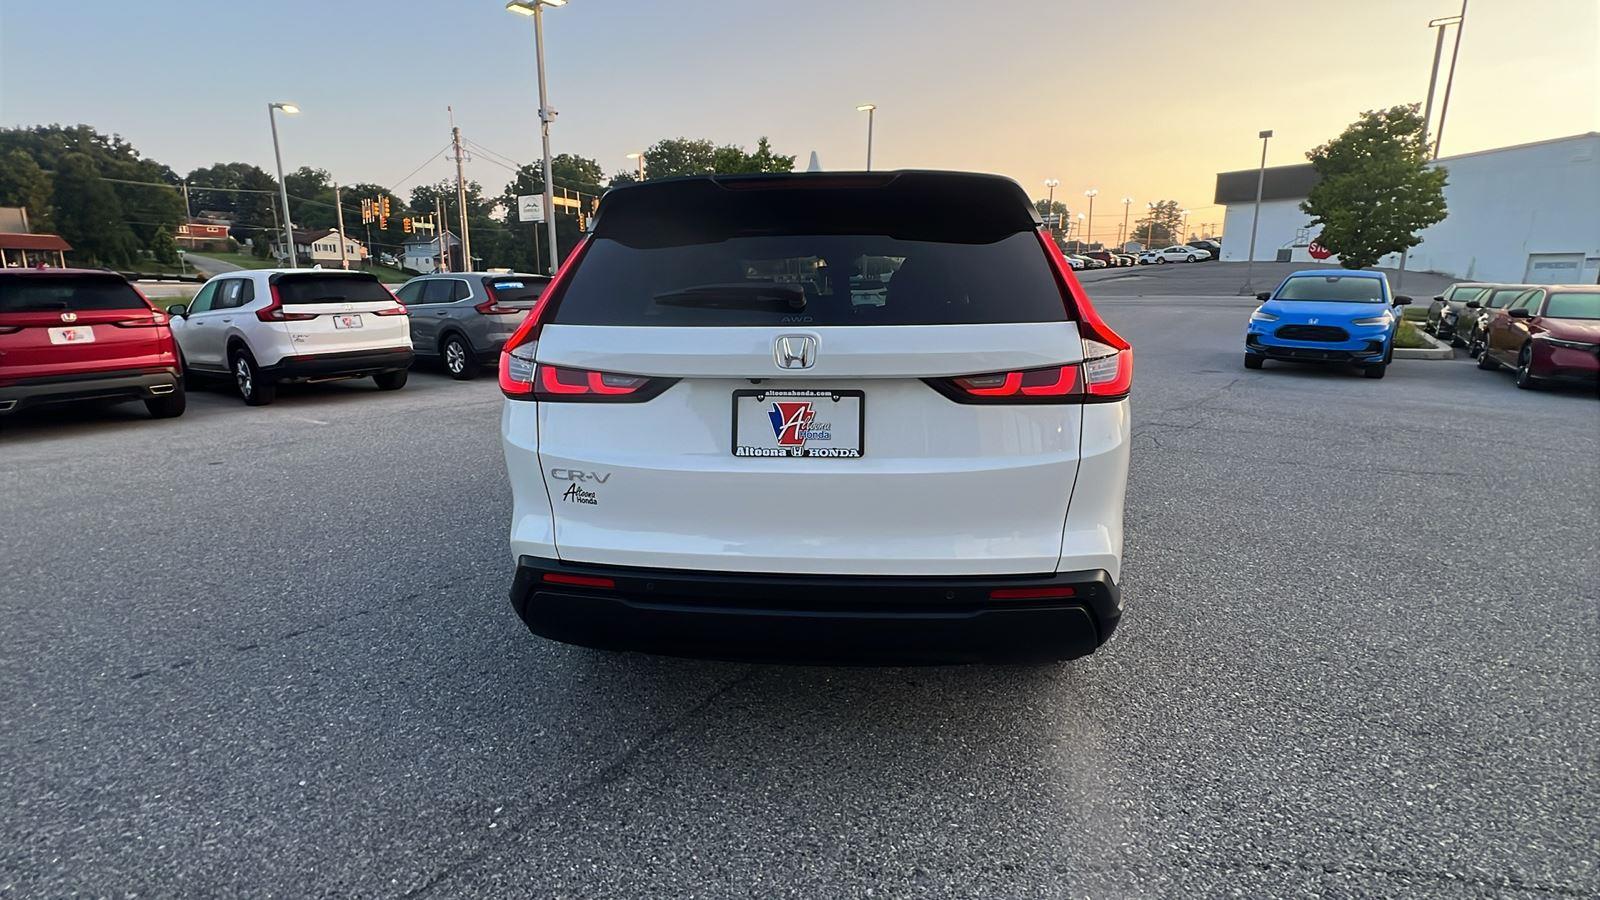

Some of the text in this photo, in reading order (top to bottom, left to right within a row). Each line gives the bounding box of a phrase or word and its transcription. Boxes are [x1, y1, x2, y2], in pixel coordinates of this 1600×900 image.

[800, 430, 831, 440] Honda
[736, 447, 787, 457] Altoona
[808, 449, 860, 457] HONDA
[551, 468, 611, 483] CR-V
